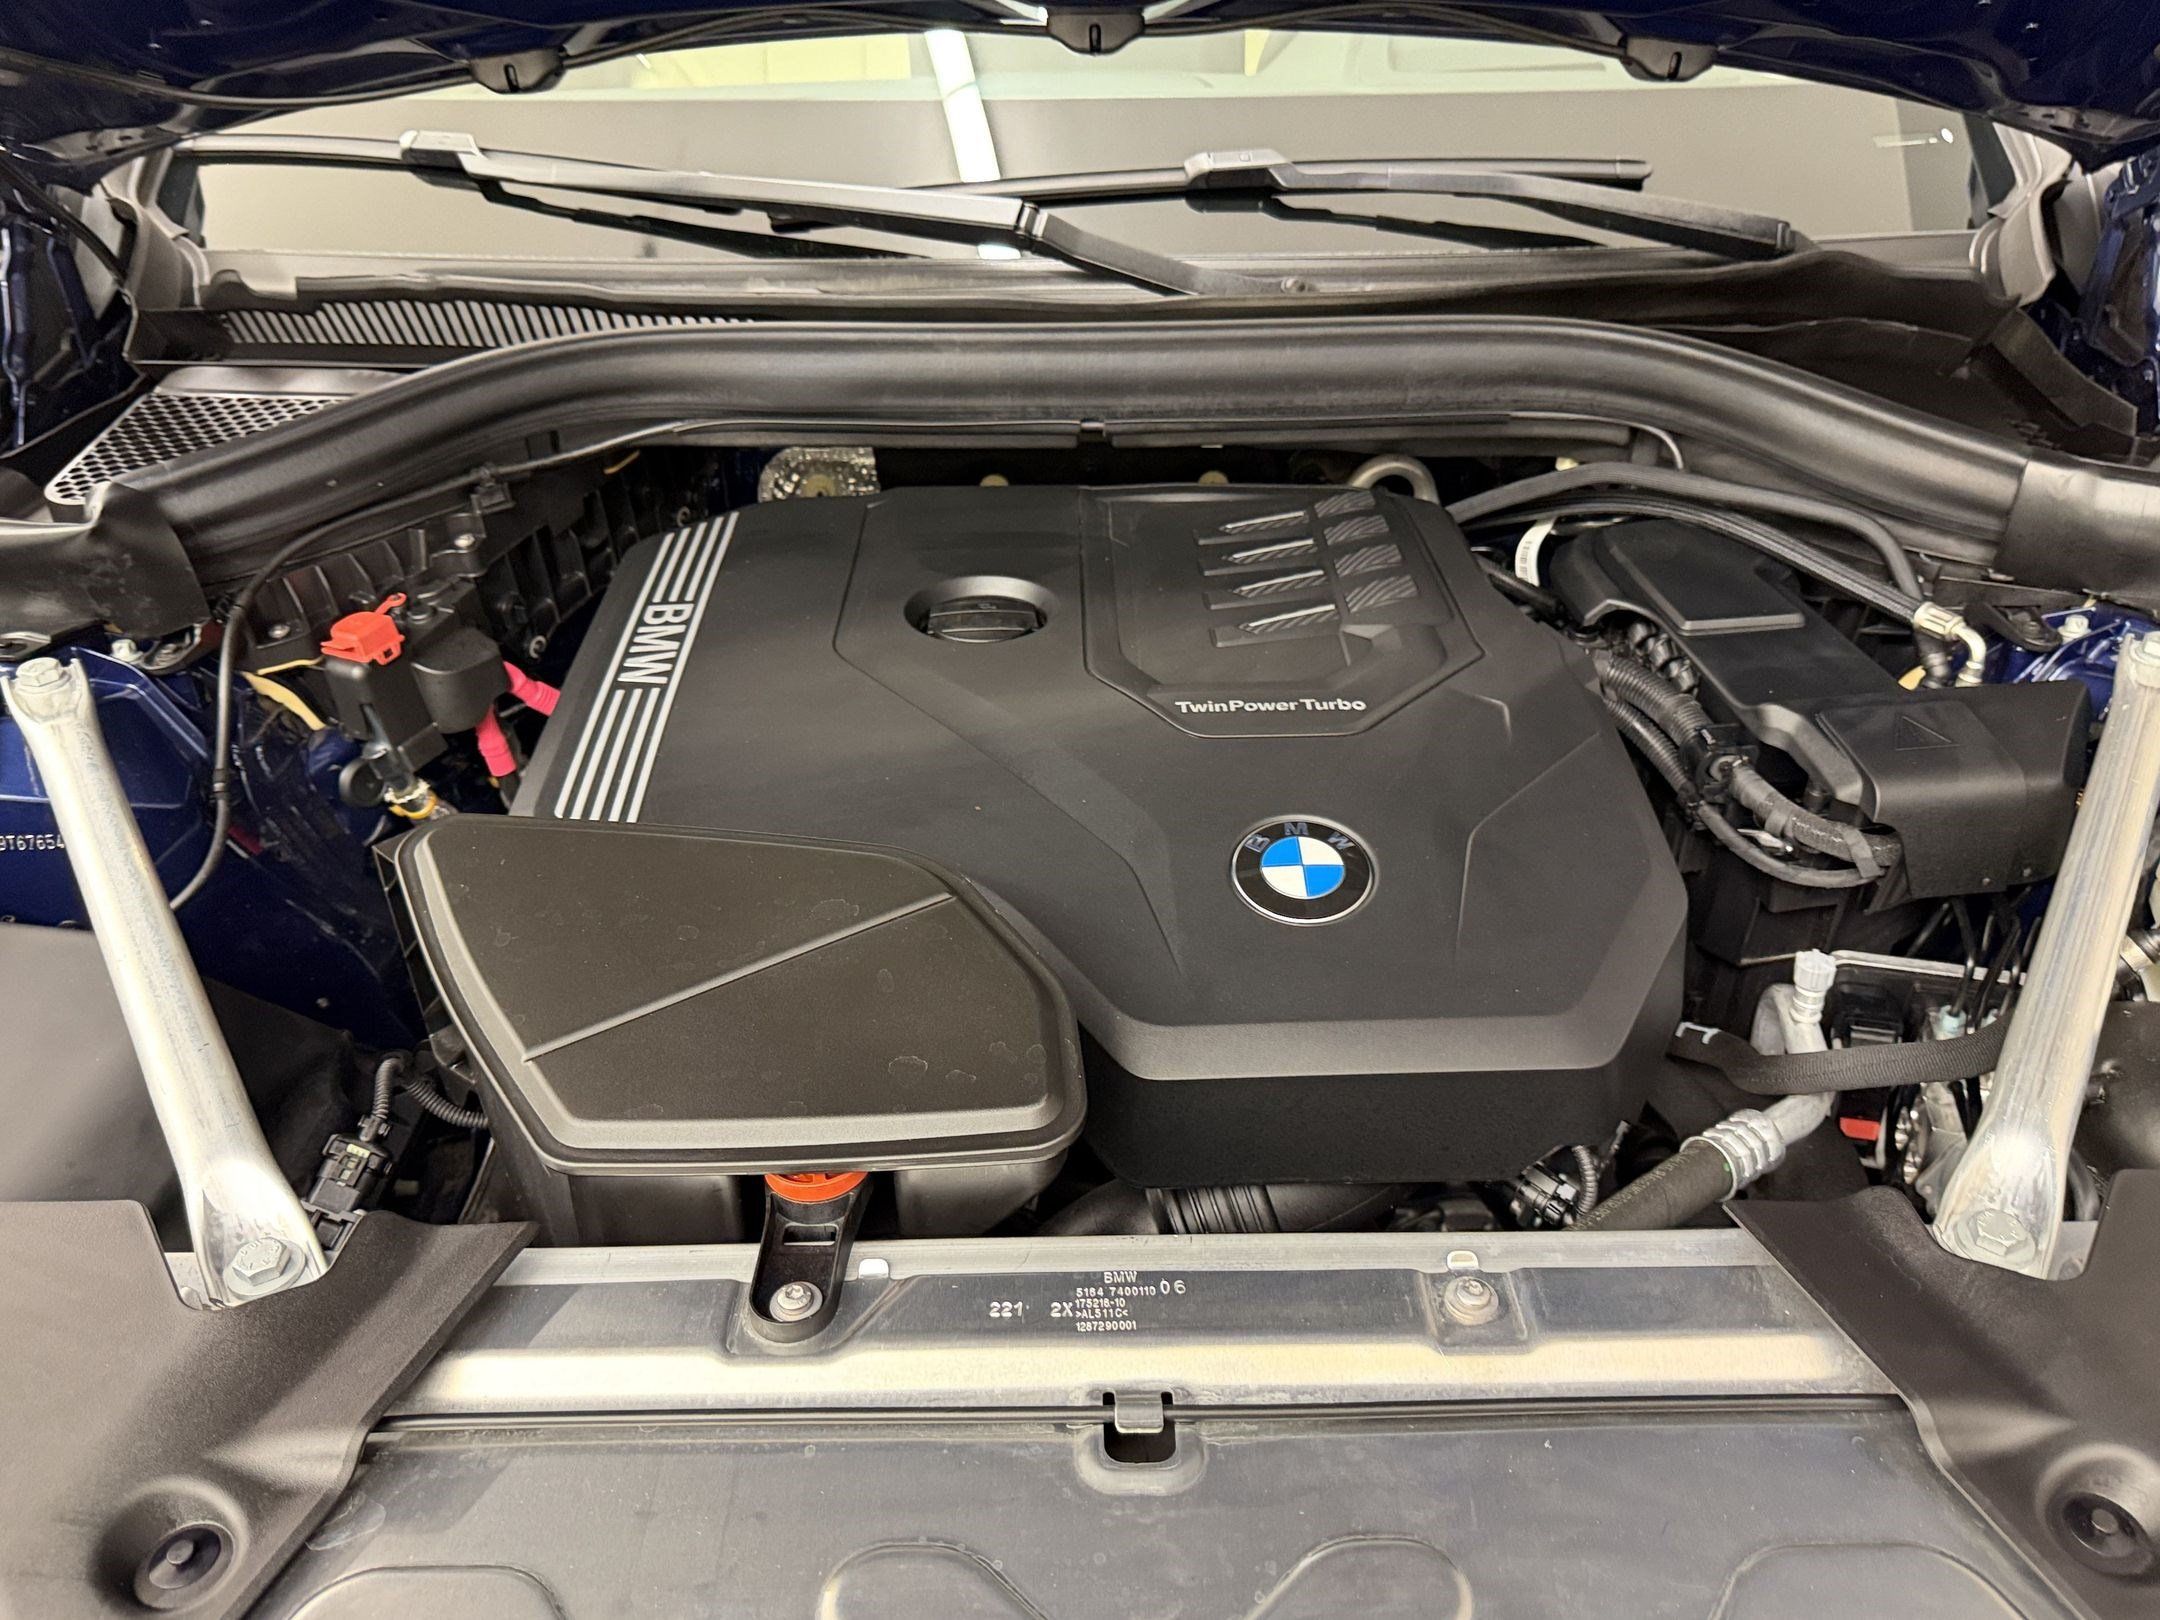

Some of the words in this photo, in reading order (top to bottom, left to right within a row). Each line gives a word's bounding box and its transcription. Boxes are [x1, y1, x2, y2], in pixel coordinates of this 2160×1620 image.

[617, 603, 695, 684] BMW
[1175, 699, 1299, 713] TwinPower
[1300, 698, 1367, 711] Turbo
[1244, 821, 1355, 853] BMW
[1103, 1270, 1138, 1284] BMW
[1109, 1286, 1157, 1297] 7400110
[1050, 1301, 1073, 1318] 2X
